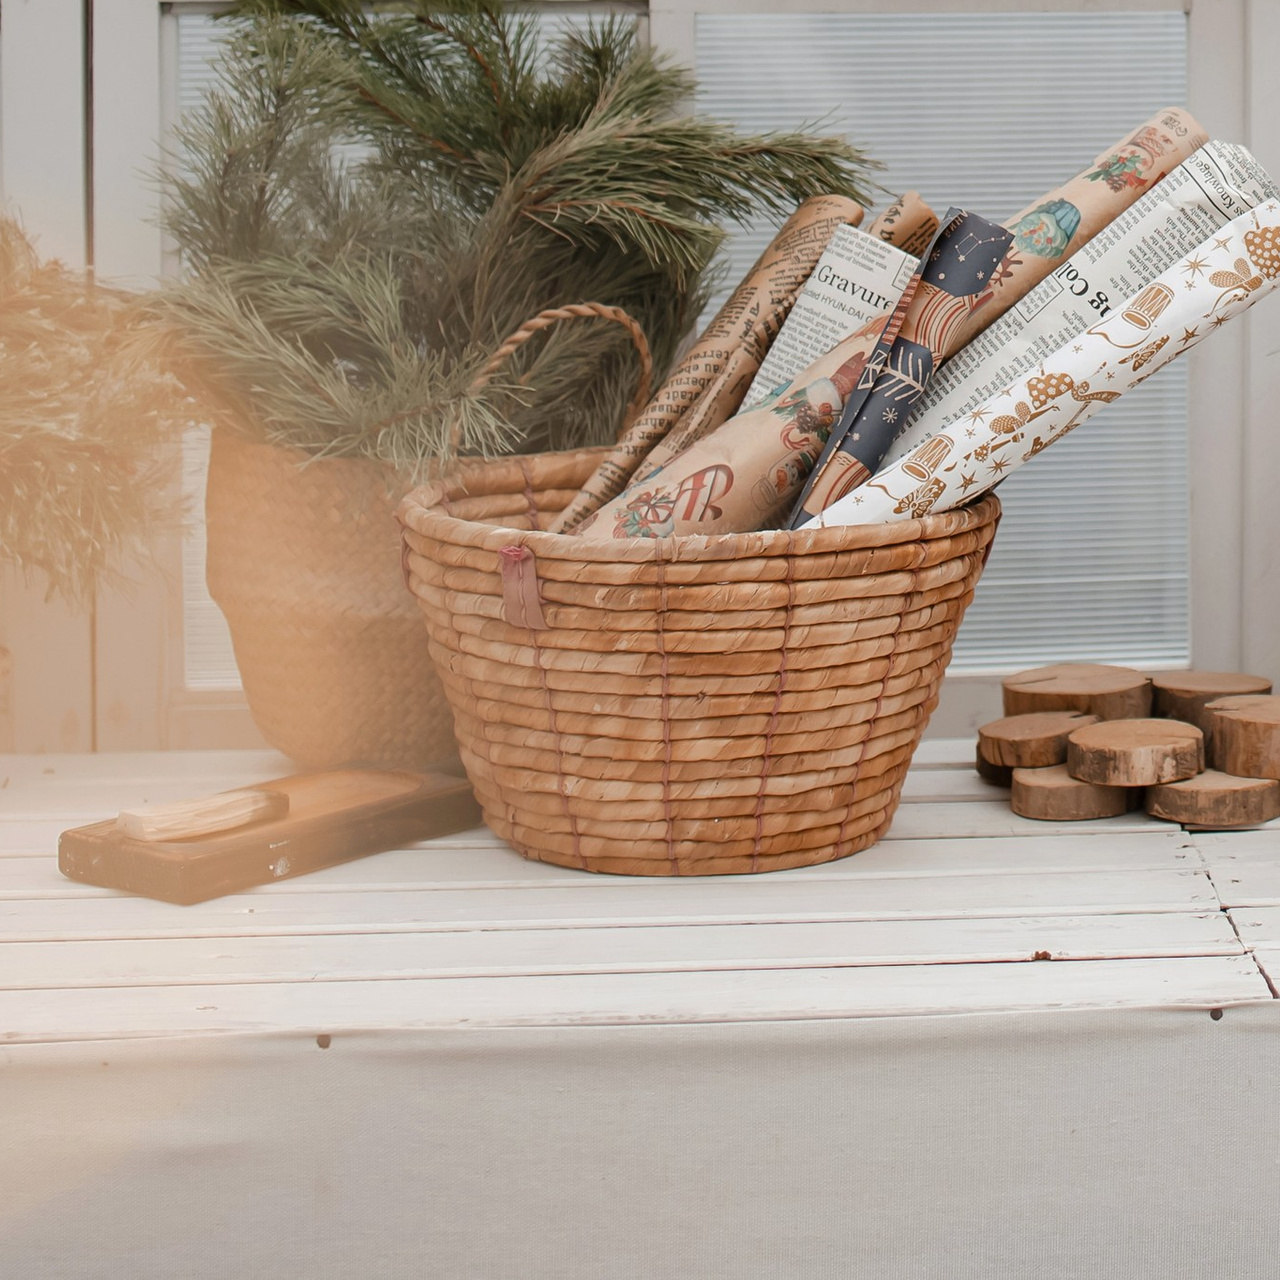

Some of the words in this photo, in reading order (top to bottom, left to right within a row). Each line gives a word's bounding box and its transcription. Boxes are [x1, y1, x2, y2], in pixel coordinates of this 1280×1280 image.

[1232, 167, 1247, 184] from
[1191, 158, 1237, 210] Knowlage
[1178, 206, 1201, 230] hunting
[1188, 206, 1202, 221] only
[1162, 226, 1170, 234] it
[1174, 215, 1191, 233] brave
[1199, 218, 1210, 230] his
[1147, 234, 1159, 246] the
[1152, 227, 1167, 242] next
[1168, 231, 1176, 240] so
[1174, 227, 1188, 241] The
[1138, 235, 1163, 263] Eskimos,
[1163, 239, 1175, 252] the
[1126, 248, 1149, 272] thirteen
[1144, 255, 1153, 264] of
[1156, 243, 1174, 263] leaves
[1124, 258, 1137, 271] the
[1133, 267, 1142, 277] of
[1107, 276, 1119, 289] fire
[1116, 273, 1131, 289] him.
[819, 294, 865, 321] HYUN-DAI
[1060, 309, 1075, 325] eyes,
[1069, 308, 1089, 330] might.
[837, 321, 848, 330] the
[1030, 339, 1041, 351] her
[1012, 356, 1024, 369] and
